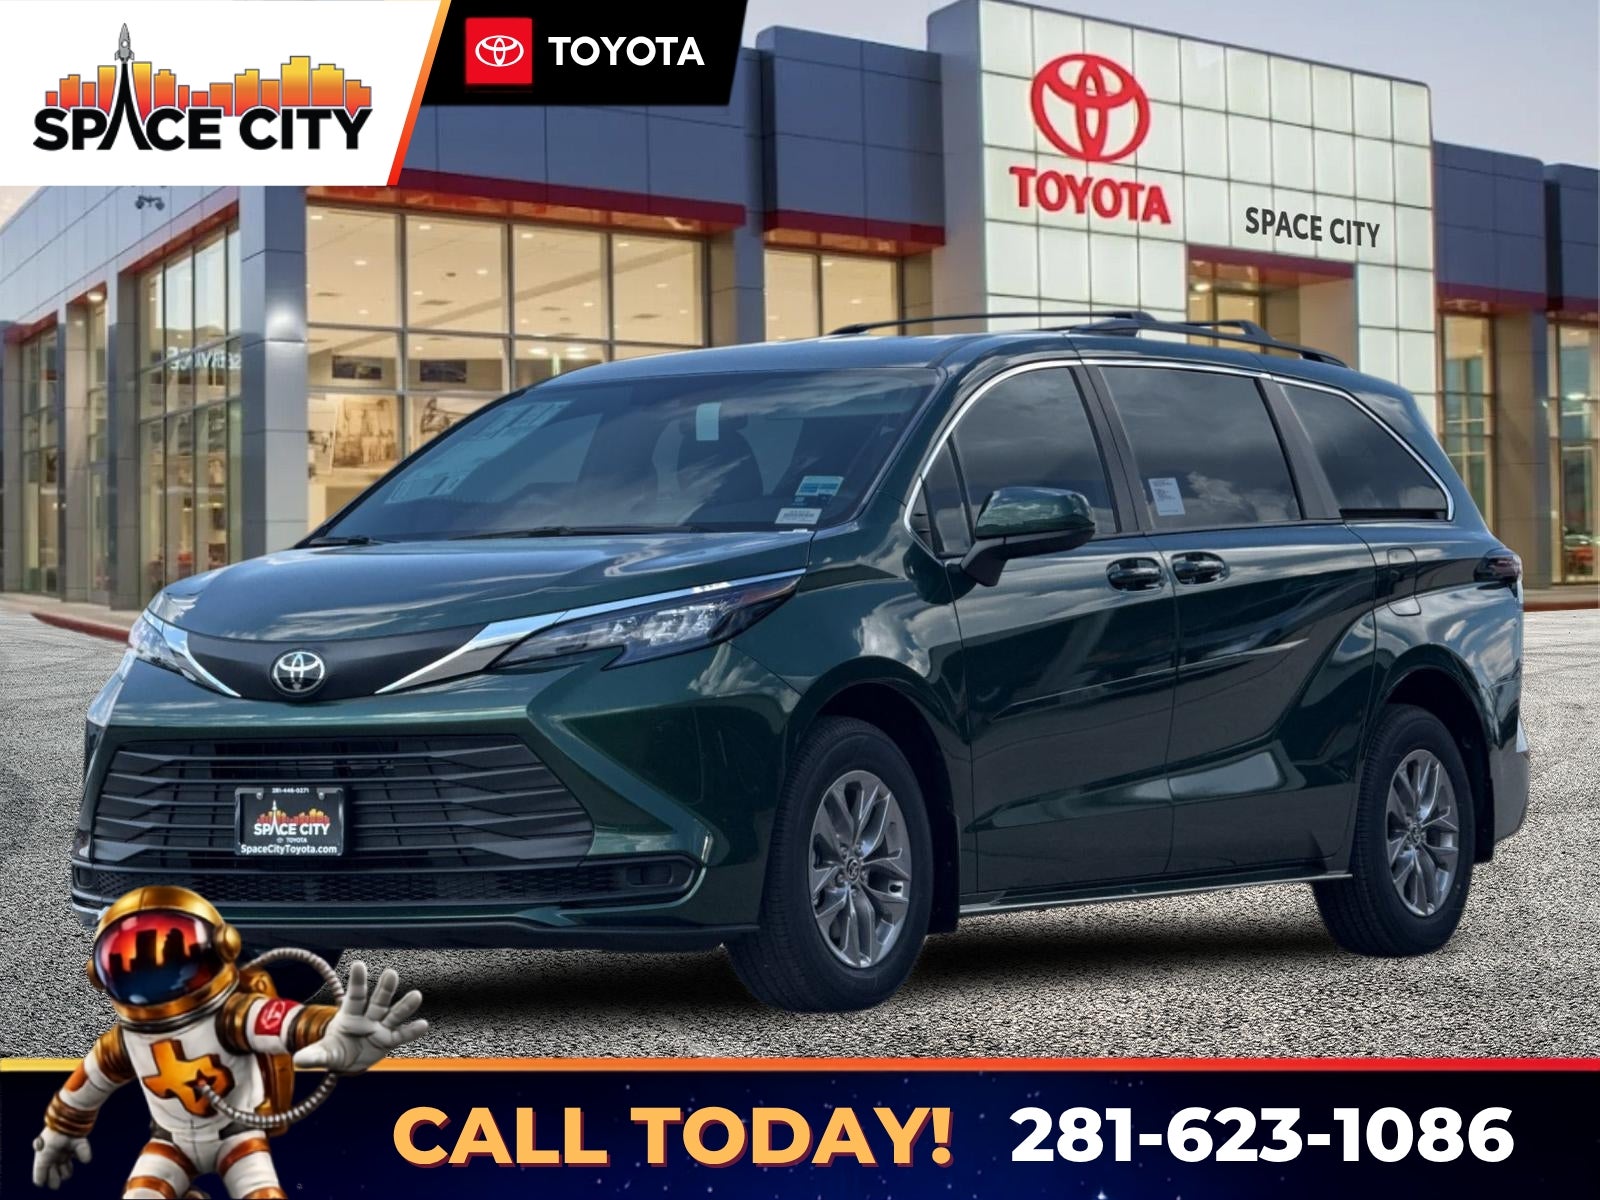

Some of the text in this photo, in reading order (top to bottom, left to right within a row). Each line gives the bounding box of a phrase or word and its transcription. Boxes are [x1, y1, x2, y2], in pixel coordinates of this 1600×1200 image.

[1009, 165, 1171, 225] TOYOTA
[1245, 207, 1381, 248] SPACE CITY
[253, 822, 331, 836] SPACE CITY
[240, 844, 338, 856] SpaceCityToyota.com
